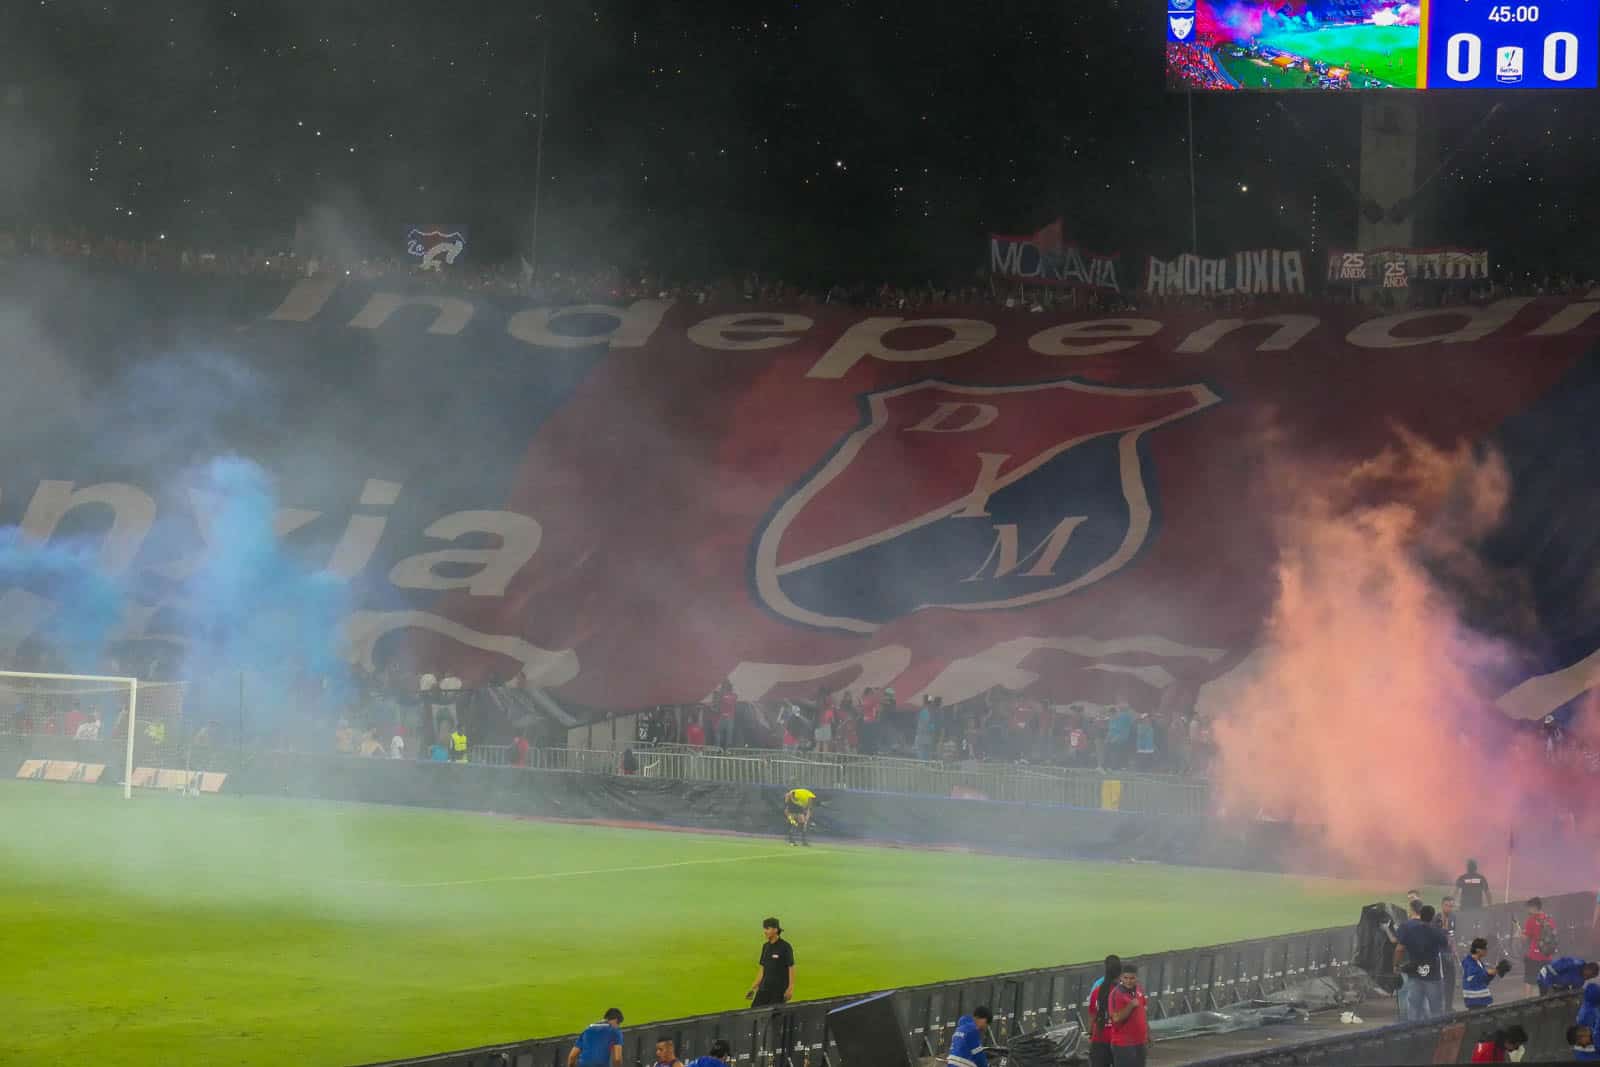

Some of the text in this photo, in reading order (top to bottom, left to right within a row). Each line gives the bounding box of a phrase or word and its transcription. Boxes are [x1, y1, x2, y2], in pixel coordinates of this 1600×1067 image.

[1488, 6, 1539, 22] 45:00
[1447, 33, 1481, 82] 0
[1543, 32, 1578, 81] 0
[1145, 249, 1306, 296] ANDALUXIA
[1343, 253, 1364, 267] 25
[1384, 262, 1405, 275] 25
